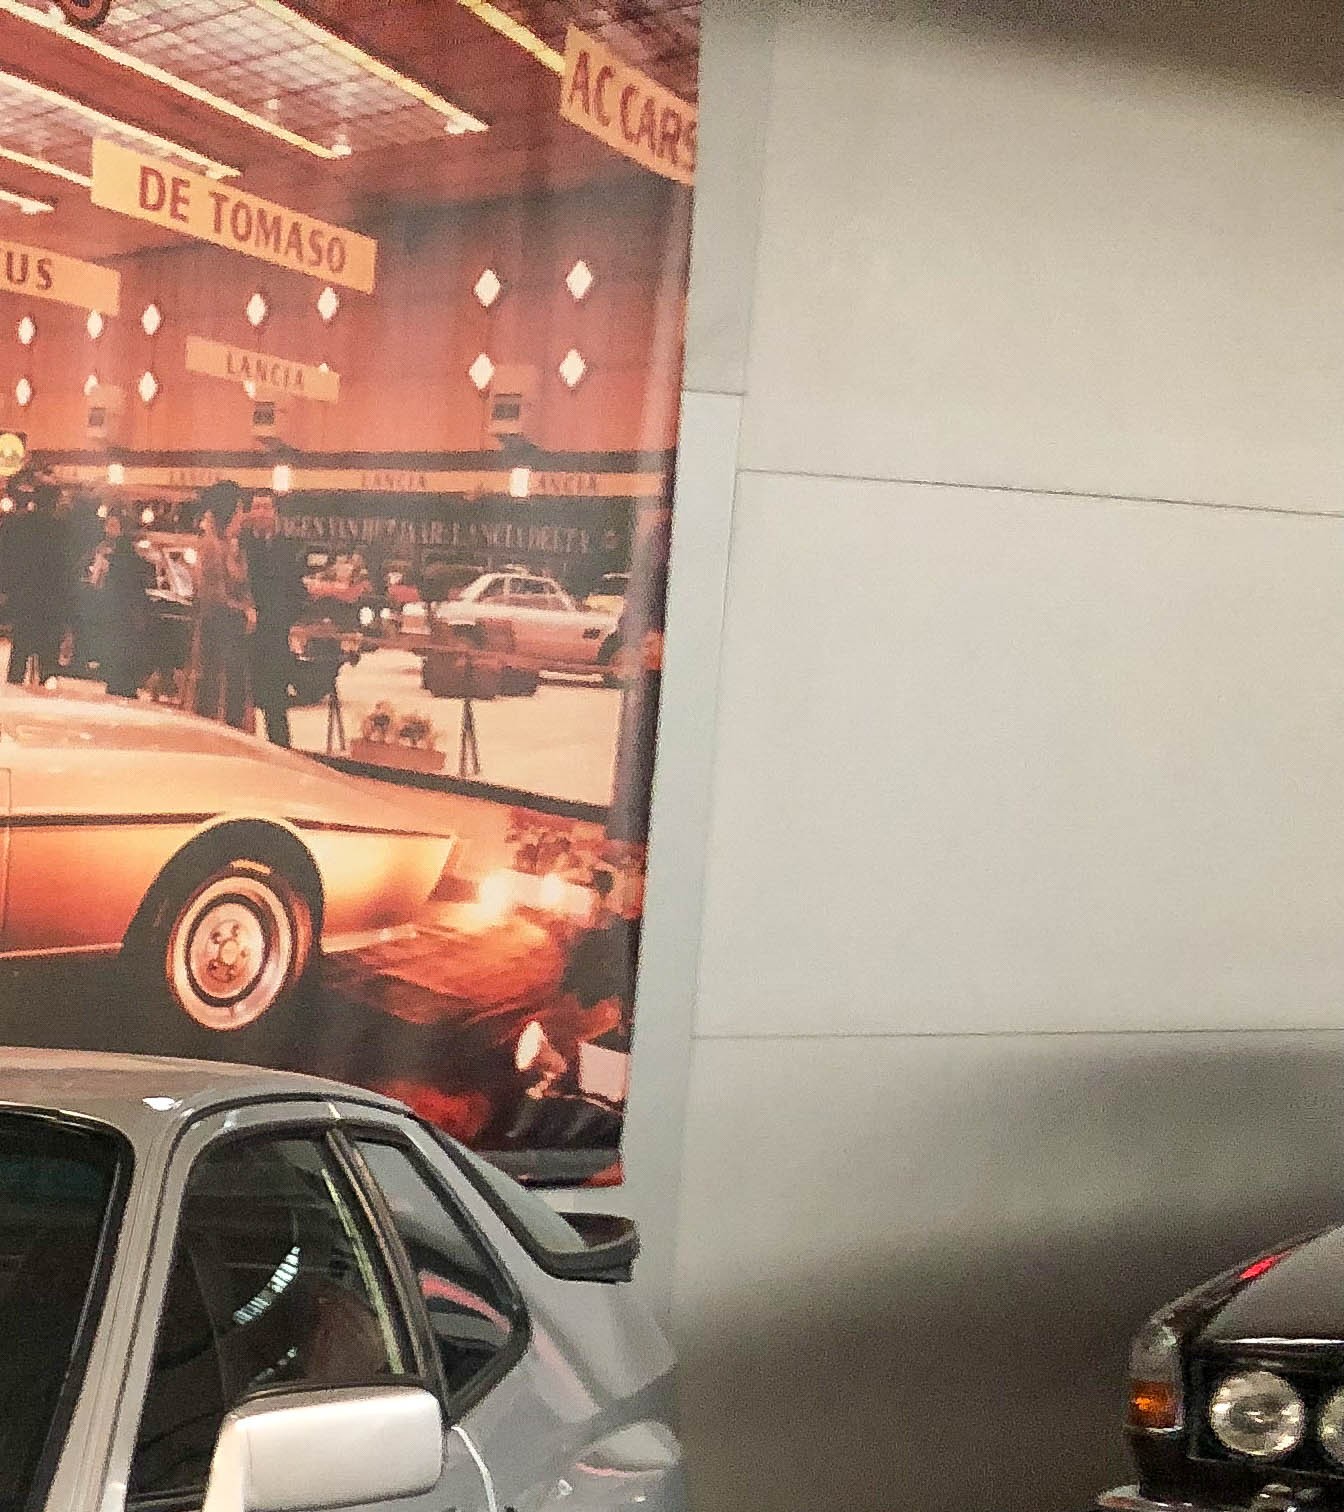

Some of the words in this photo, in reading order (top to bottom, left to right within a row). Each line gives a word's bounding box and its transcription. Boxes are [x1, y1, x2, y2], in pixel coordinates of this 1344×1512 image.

[569, 50, 616, 126] AC
[138, 165, 192, 224] DE
[208, 190, 347, 274] TOMASO
[226, 351, 305, 387] LANCIA
